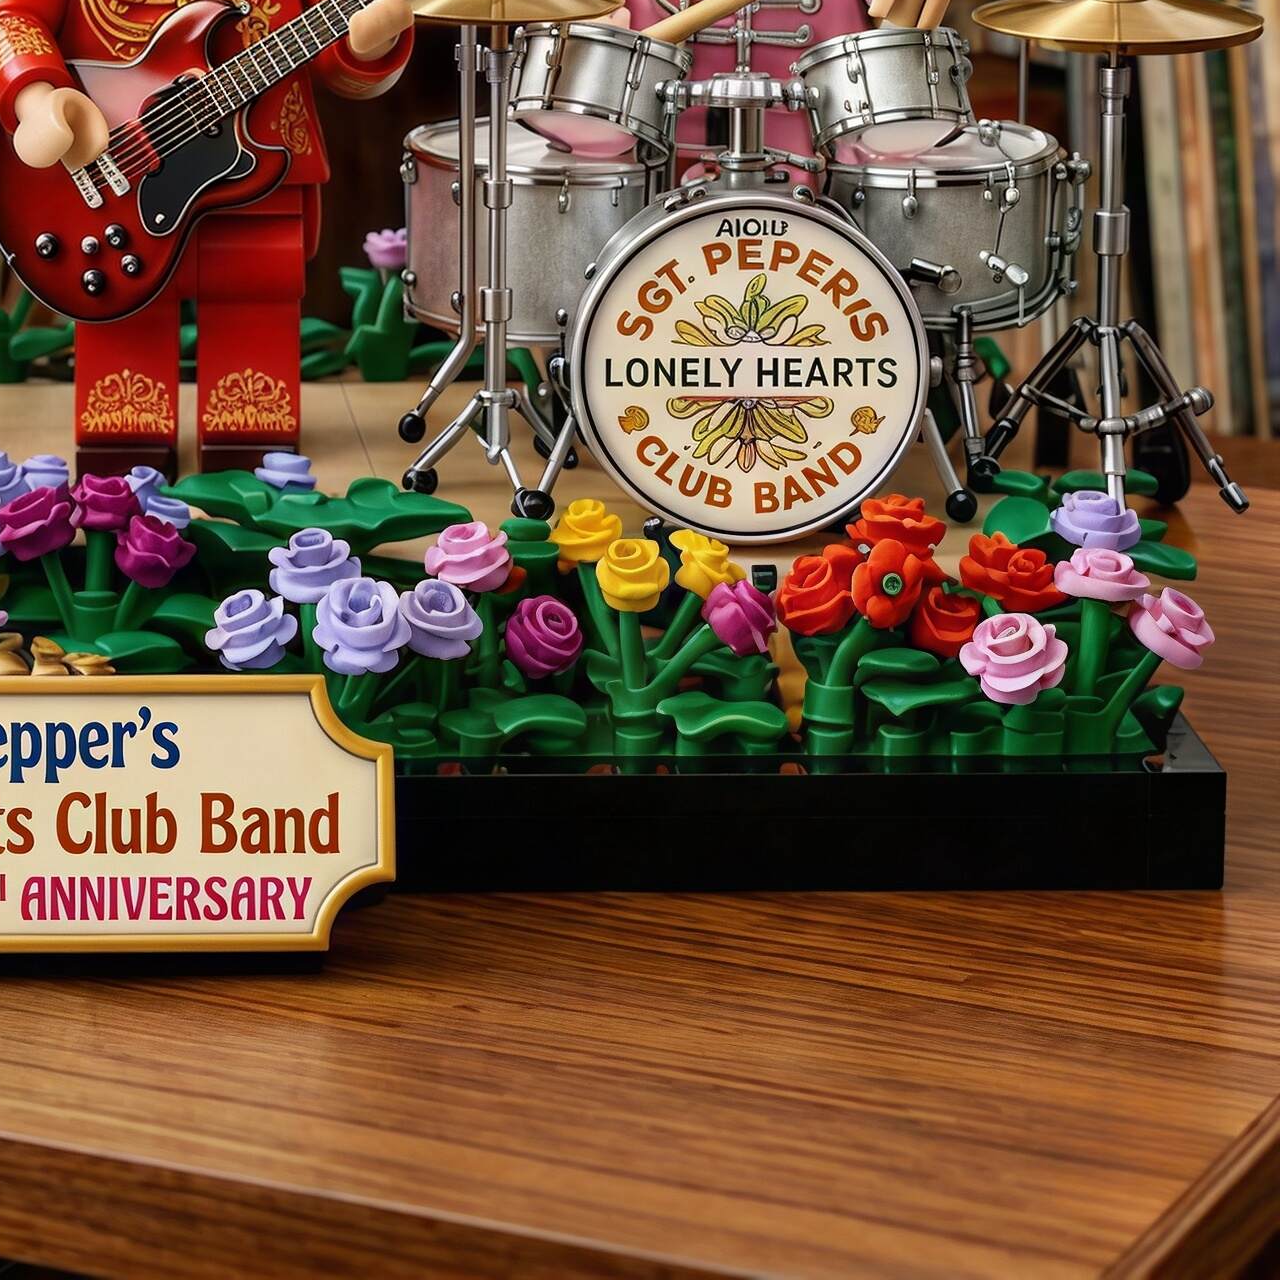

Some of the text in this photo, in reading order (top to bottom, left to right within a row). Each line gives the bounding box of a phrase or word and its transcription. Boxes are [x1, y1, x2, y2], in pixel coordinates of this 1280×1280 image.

[605, 357, 898, 388] LONELY HEARTS
[635, 435, 863, 514] CLUB BAND
[56, 792, 178, 855] Club
[200, 792, 341, 855] Band
[21, 876, 313, 921] ANNIVERSARY
